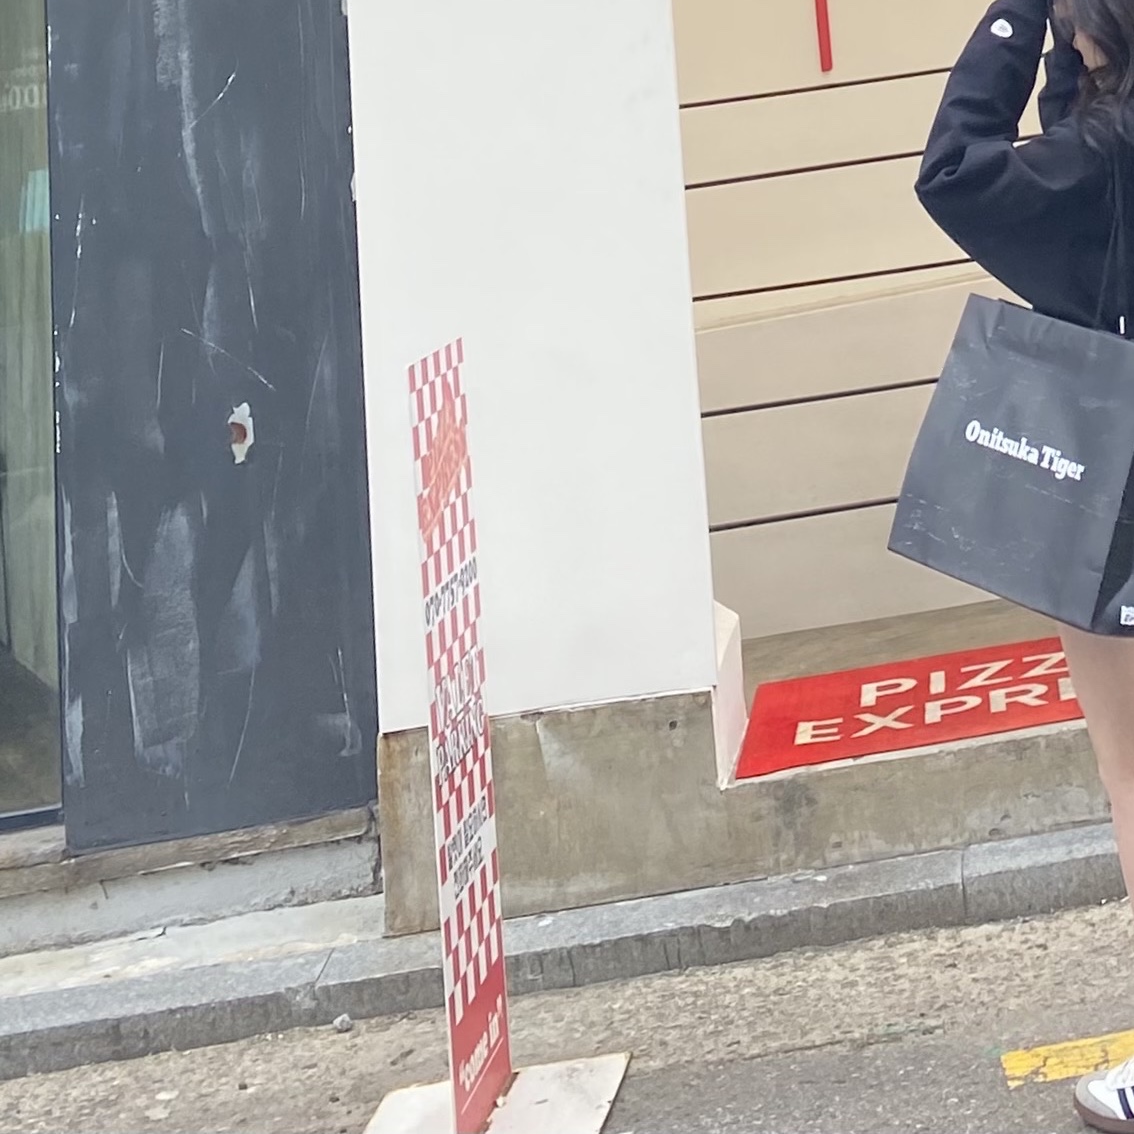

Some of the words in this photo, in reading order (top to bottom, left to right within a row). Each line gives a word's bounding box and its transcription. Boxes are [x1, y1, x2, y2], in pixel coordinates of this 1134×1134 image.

[965, 419, 1039, 465] Onitsuka
[1039, 445, 1086, 481] Tiger
[434, 645, 480, 732] VALET
[859, 651, 1070, 708] PIZZ
[436, 697, 485, 787] PARKING
